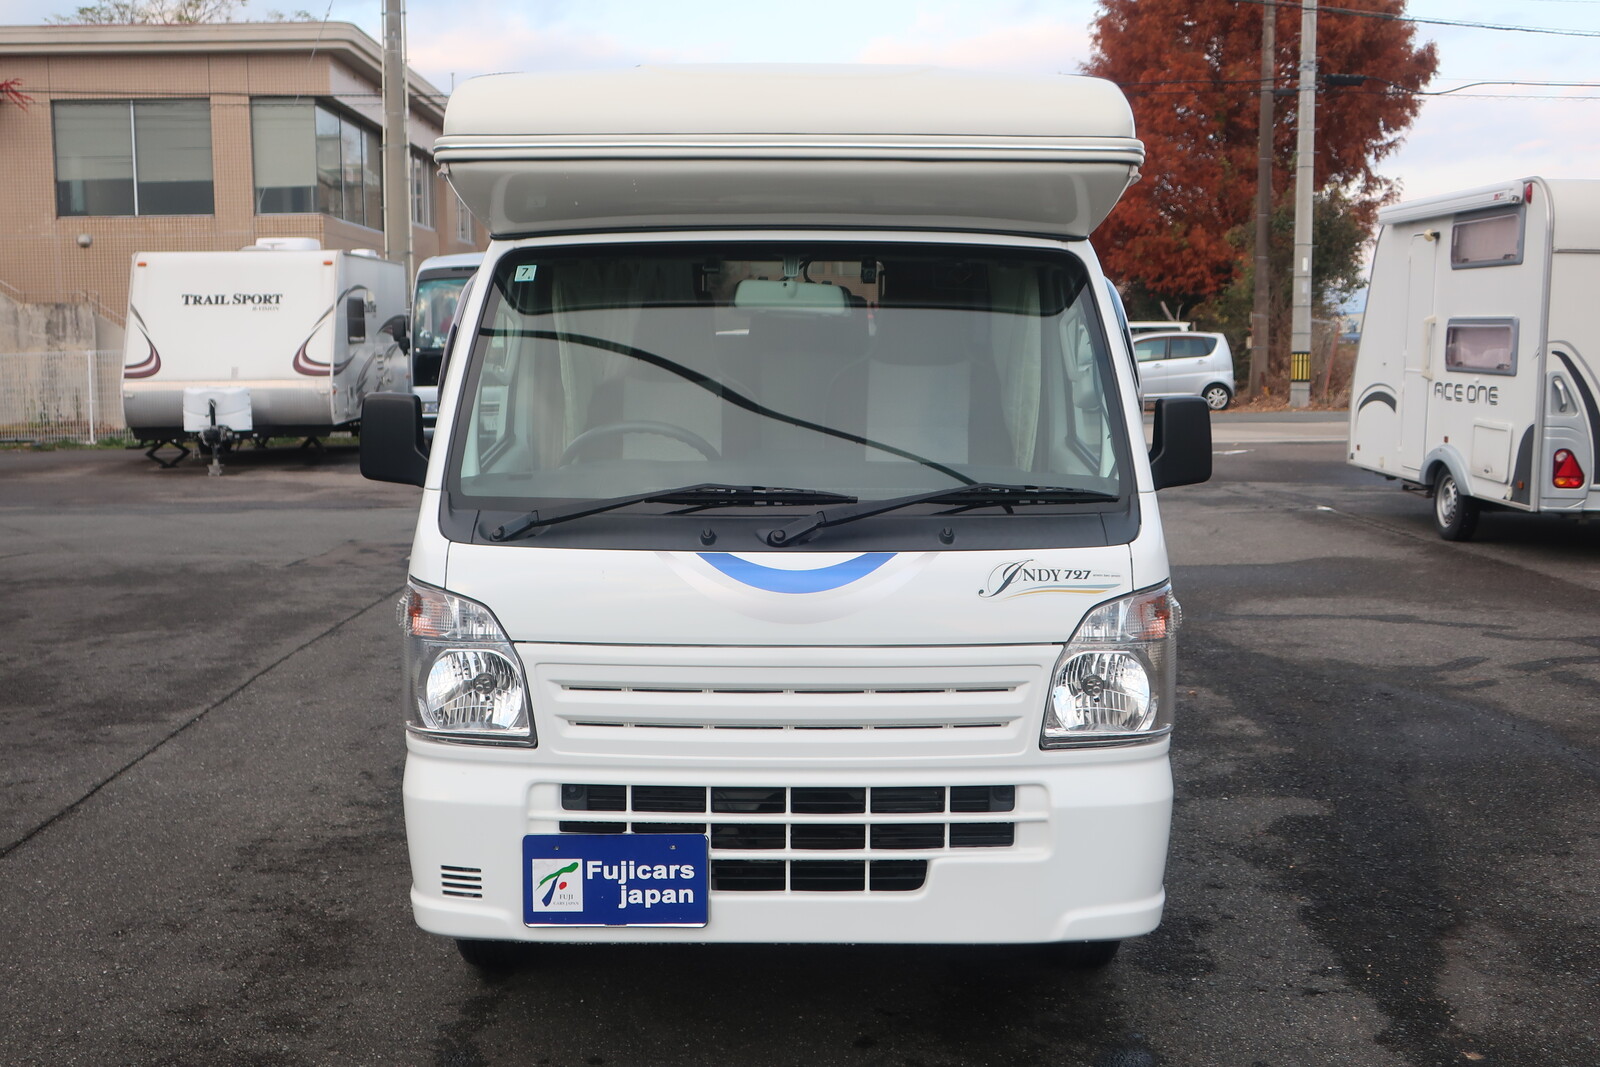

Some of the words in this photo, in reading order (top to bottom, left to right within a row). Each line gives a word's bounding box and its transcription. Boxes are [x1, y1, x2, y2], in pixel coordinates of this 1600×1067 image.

[181, 294, 230, 305] TRAIL
[232, 293, 283, 305] SPORT
[1434, 382, 1463, 402] ACE
[1467, 384, 1498, 405] ONE
[978, 559, 1061, 598] INDY
[1064, 569, 1092, 580] 727
[586, 860, 695, 885] Fujicars
[618, 885, 694, 909] japan
